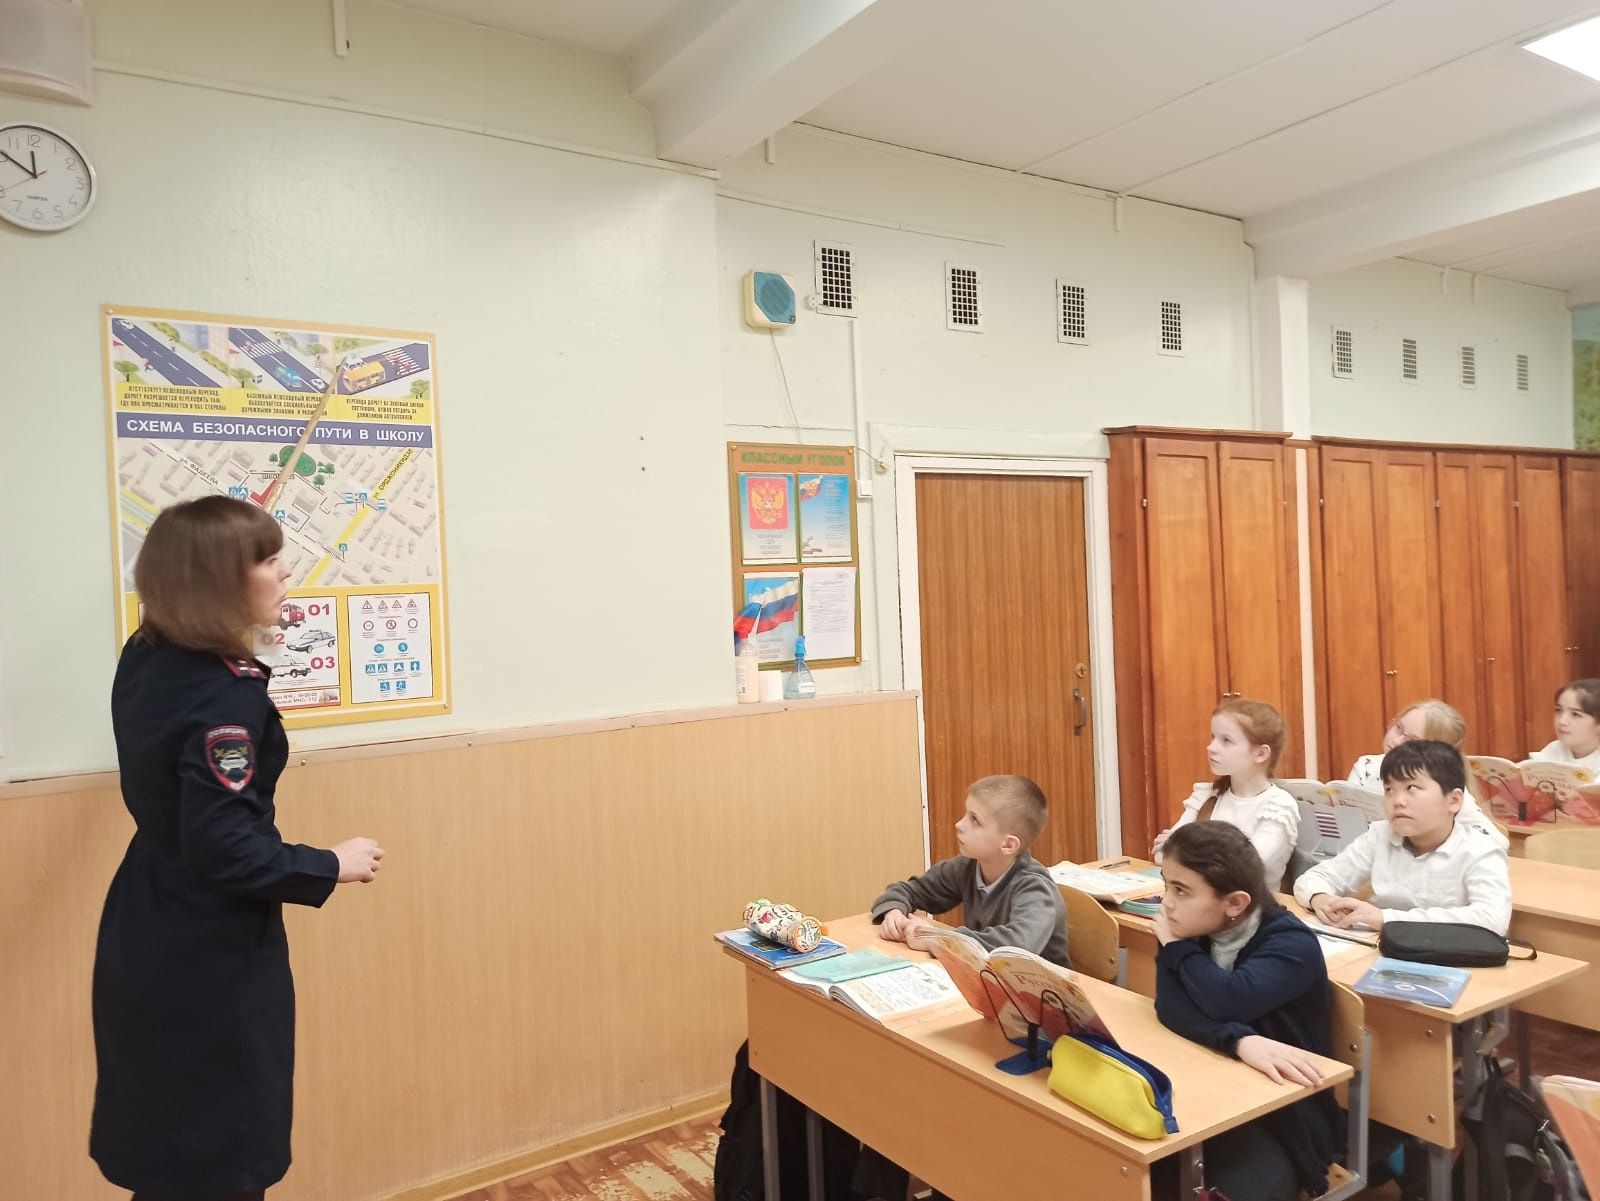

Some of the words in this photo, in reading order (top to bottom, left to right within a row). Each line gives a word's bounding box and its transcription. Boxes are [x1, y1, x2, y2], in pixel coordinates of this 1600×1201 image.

[9, 135, 19, 150] 11
[27, 133, 41, 148] 12
[53, 141, 58, 153] 1
[65, 157, 77, 171] 2
[74, 175, 85, 190] 3
[11, 199, 24, 213] 7
[68, 194, 78, 208] 4
[32, 206, 44, 221] 6
[54, 204, 64, 219] 5
[126, 419, 185, 433] СХЕМА
[192, 421, 306, 438] БЕЗОПАСНОГО
[315, 426, 352, 439] ПУТИ
[359, 429, 369, 440] В
[376, 430, 425, 442] ШКОЛУ
[190, 463, 219, 485] ФАДЕЕВА
[308, 604, 330, 616] 01
[310, 656, 336, 670] 03
